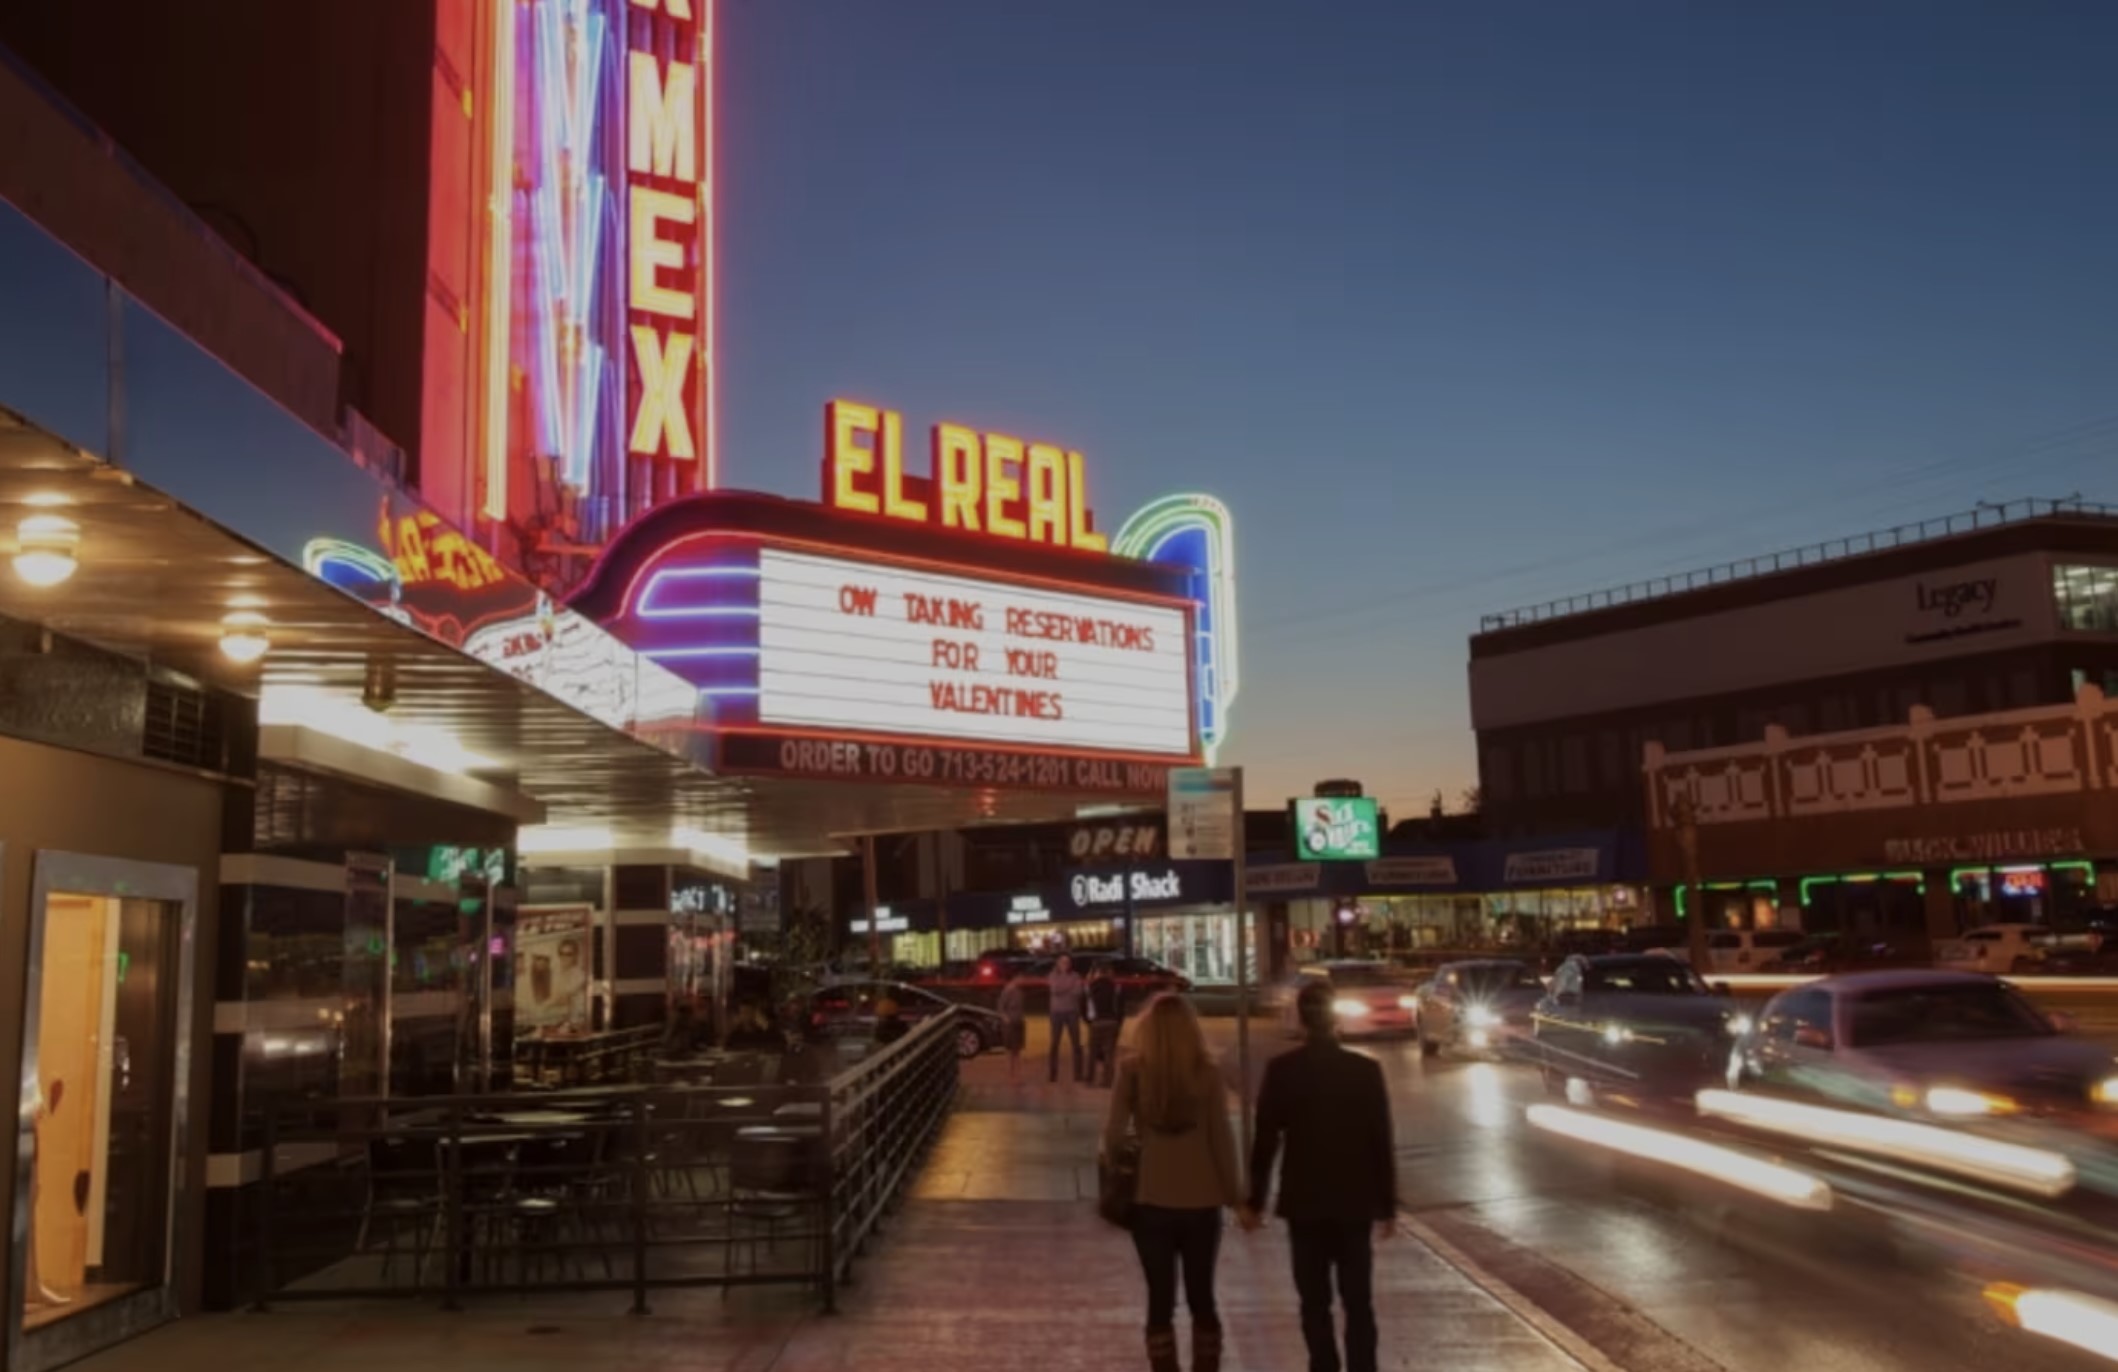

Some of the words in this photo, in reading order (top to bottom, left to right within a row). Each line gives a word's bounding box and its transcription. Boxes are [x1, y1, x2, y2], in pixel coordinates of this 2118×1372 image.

[629, 48, 696, 460] MEX
[834, 399, 927, 522] EL
[939, 422, 1108, 552] REAL
[1915, 578, 1997, 617] Legacy
[904, 593, 983, 630] TAKING
[1006, 607, 1154, 651] RESERVATIONS
[931, 638, 979, 671] FOR
[1005, 647, 1058, 679] YOUR
[929, 679, 1062, 719] VALENTINES
[781, 740, 860, 773] ORDER
[867, 745, 896, 774] TO
[902, 748, 934, 776] GO
[938, 752, 1069, 783] 713-524-1201
[1075, 761, 1122, 787] CALL
[1071, 827, 1157, 856] OPEN
